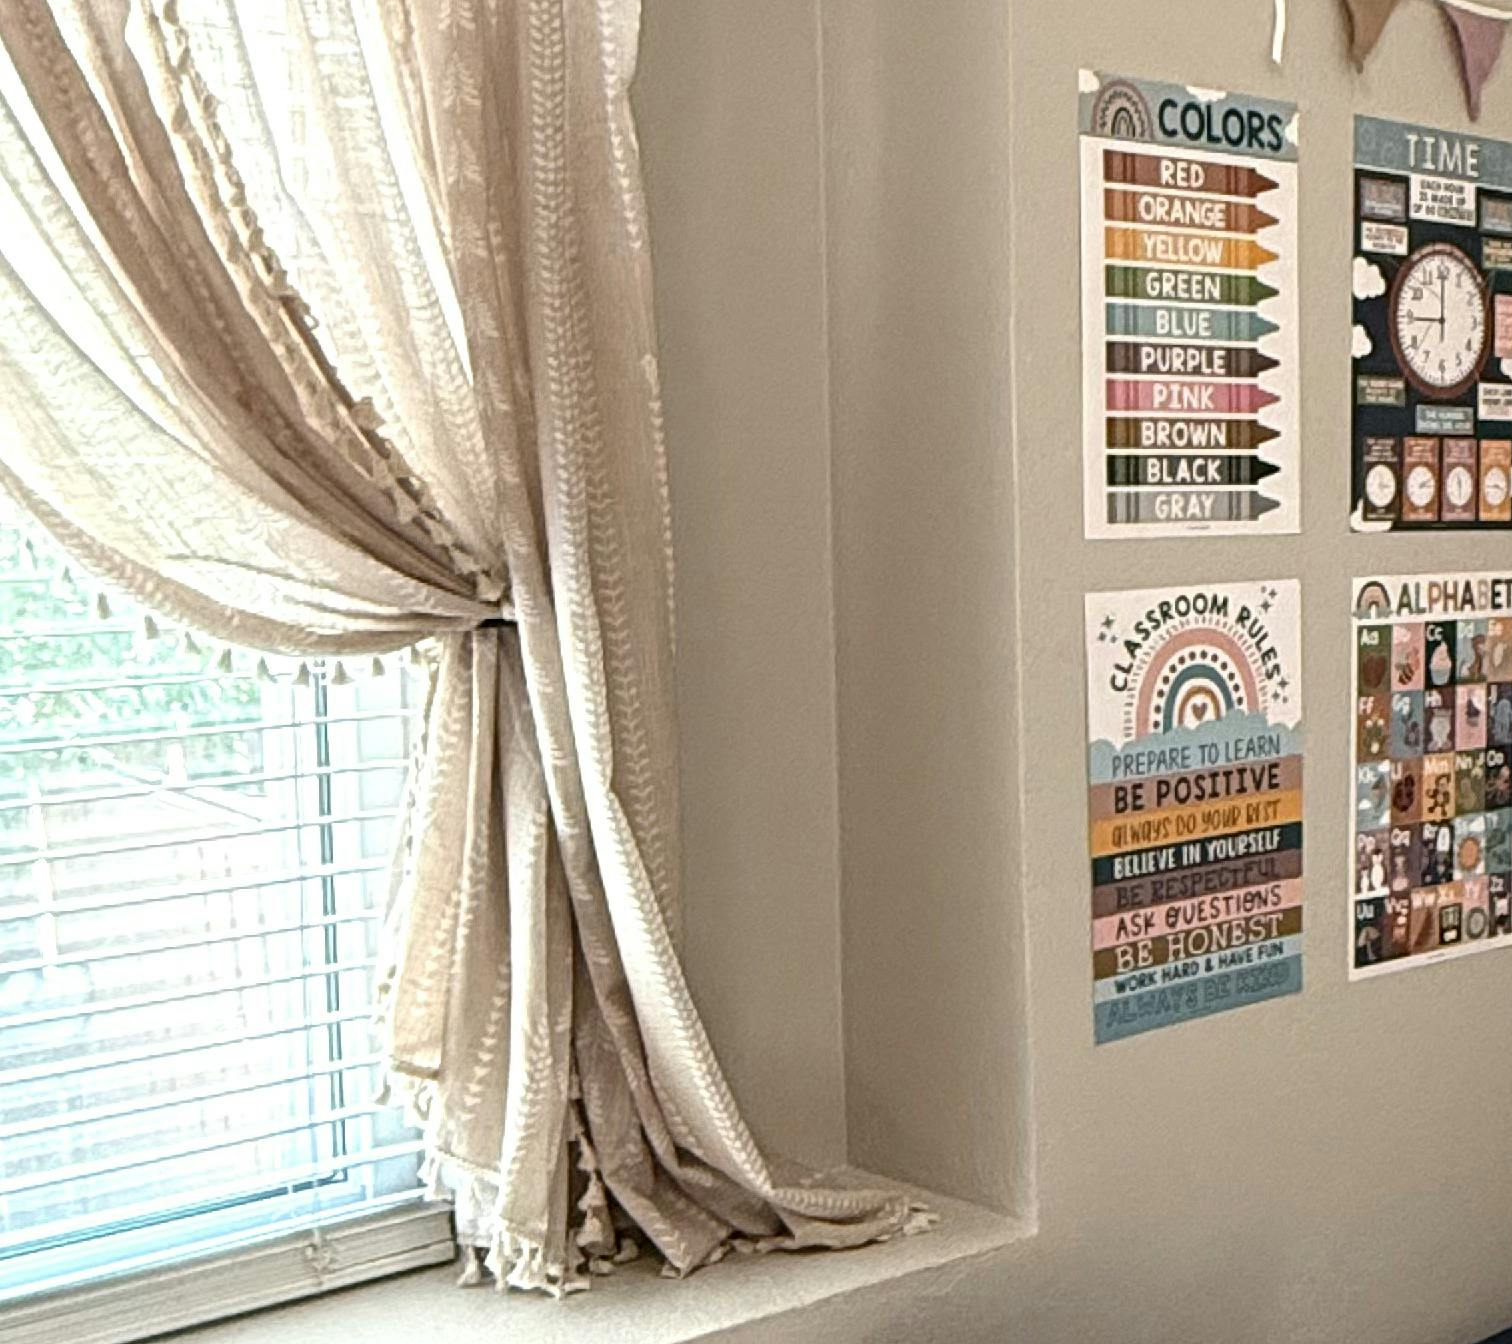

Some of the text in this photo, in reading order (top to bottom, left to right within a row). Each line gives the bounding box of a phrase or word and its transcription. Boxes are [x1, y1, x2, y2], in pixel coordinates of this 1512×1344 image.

[1158, 97, 1284, 153] COLORS
[1160, 159, 1205, 189] RED
[1406, 134, 1480, 177] TIME
[1138, 194, 1226, 229] ORANGE
[1141, 232, 1224, 265] YELLOW
[1146, 272, 1221, 301] GREEN
[1156, 309, 1212, 337] BLUE
[1141, 346, 1226, 376] PURPLE
[1152, 383, 1214, 410] PINK
[1141, 421, 1227, 448] BROWN
[1146, 457, 1222, 483] BLACK
[1155, 493, 1215, 521] GRAY
[1110, 592, 1281, 692] CLASSROOM RULES
[1112, 733, 1281, 777] PREPARE TO LEARN
[1114, 763, 1280, 813] BE POSITIVE
[1176, 813, 1198, 836] DO
[1114, 828, 1282, 880] BELIEVE IN YOURSELF
[1116, 856, 1281, 910] BE RESPECTFUL
[1116, 884, 1282, 941] ASK QUESTIONS
[1114, 913, 1284, 974] BE HONEST
[1114, 941, 1284, 993] WORK HARD & HAVE FUN
[1107, 983, 1198, 1028] ALWAYS
[1204, 974, 1232, 1001] BE
